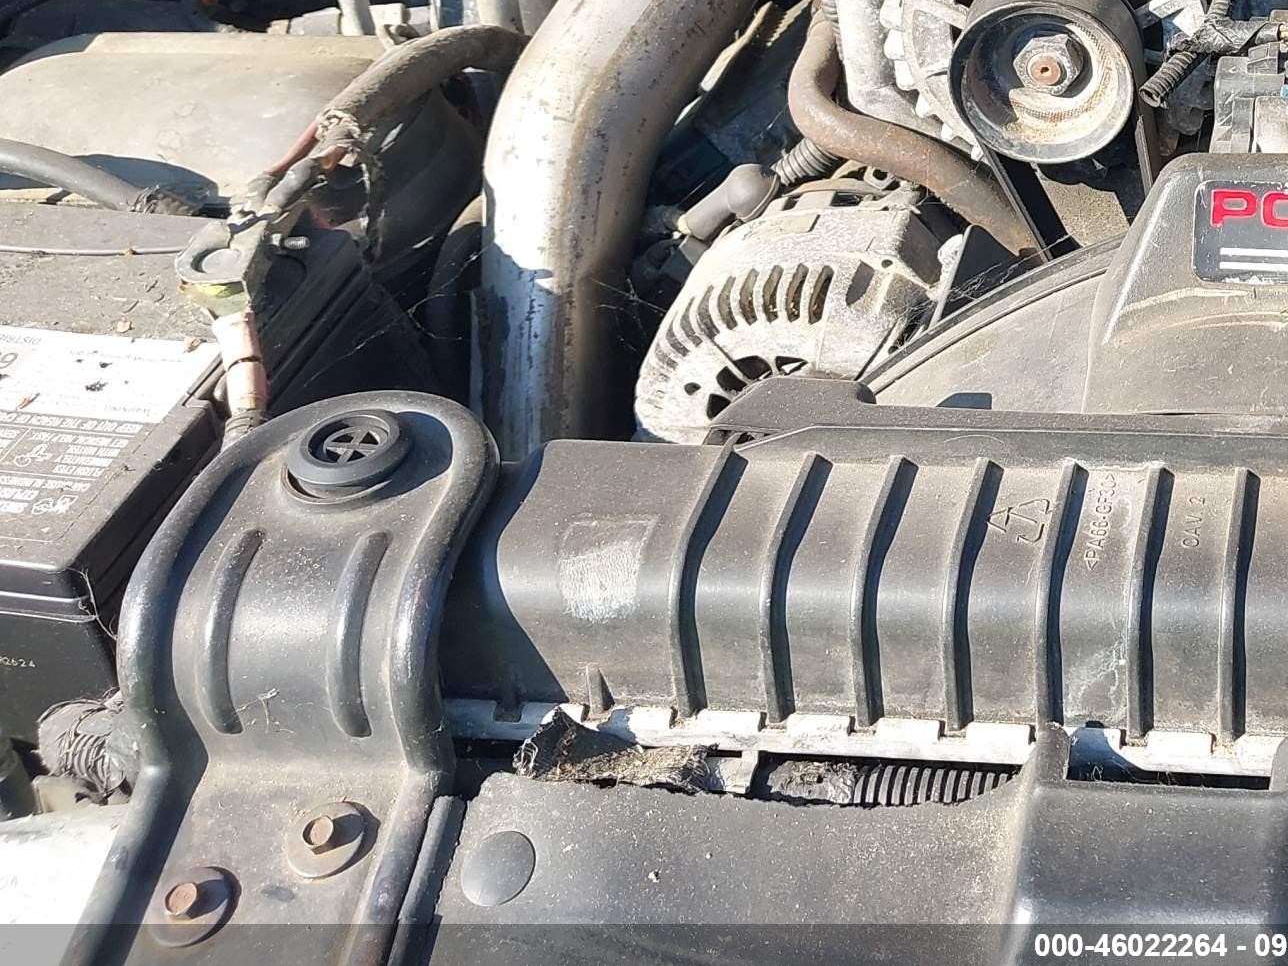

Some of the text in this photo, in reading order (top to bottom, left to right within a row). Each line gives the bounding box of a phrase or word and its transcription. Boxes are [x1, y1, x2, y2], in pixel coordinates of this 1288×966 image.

[29, 415, 64, 427] REACH
[60, 418, 81, 429] THE
[80, 420, 98, 431] OF
[97, 421, 118, 432] OUT
[115, 423, 144, 434] KEEP
[53, 434, 77, 444] HELP
[76, 436, 113, 447] MEDICAL
[111, 438, 129, 448] GET
[75, 466, 105, 476] FLUSH
